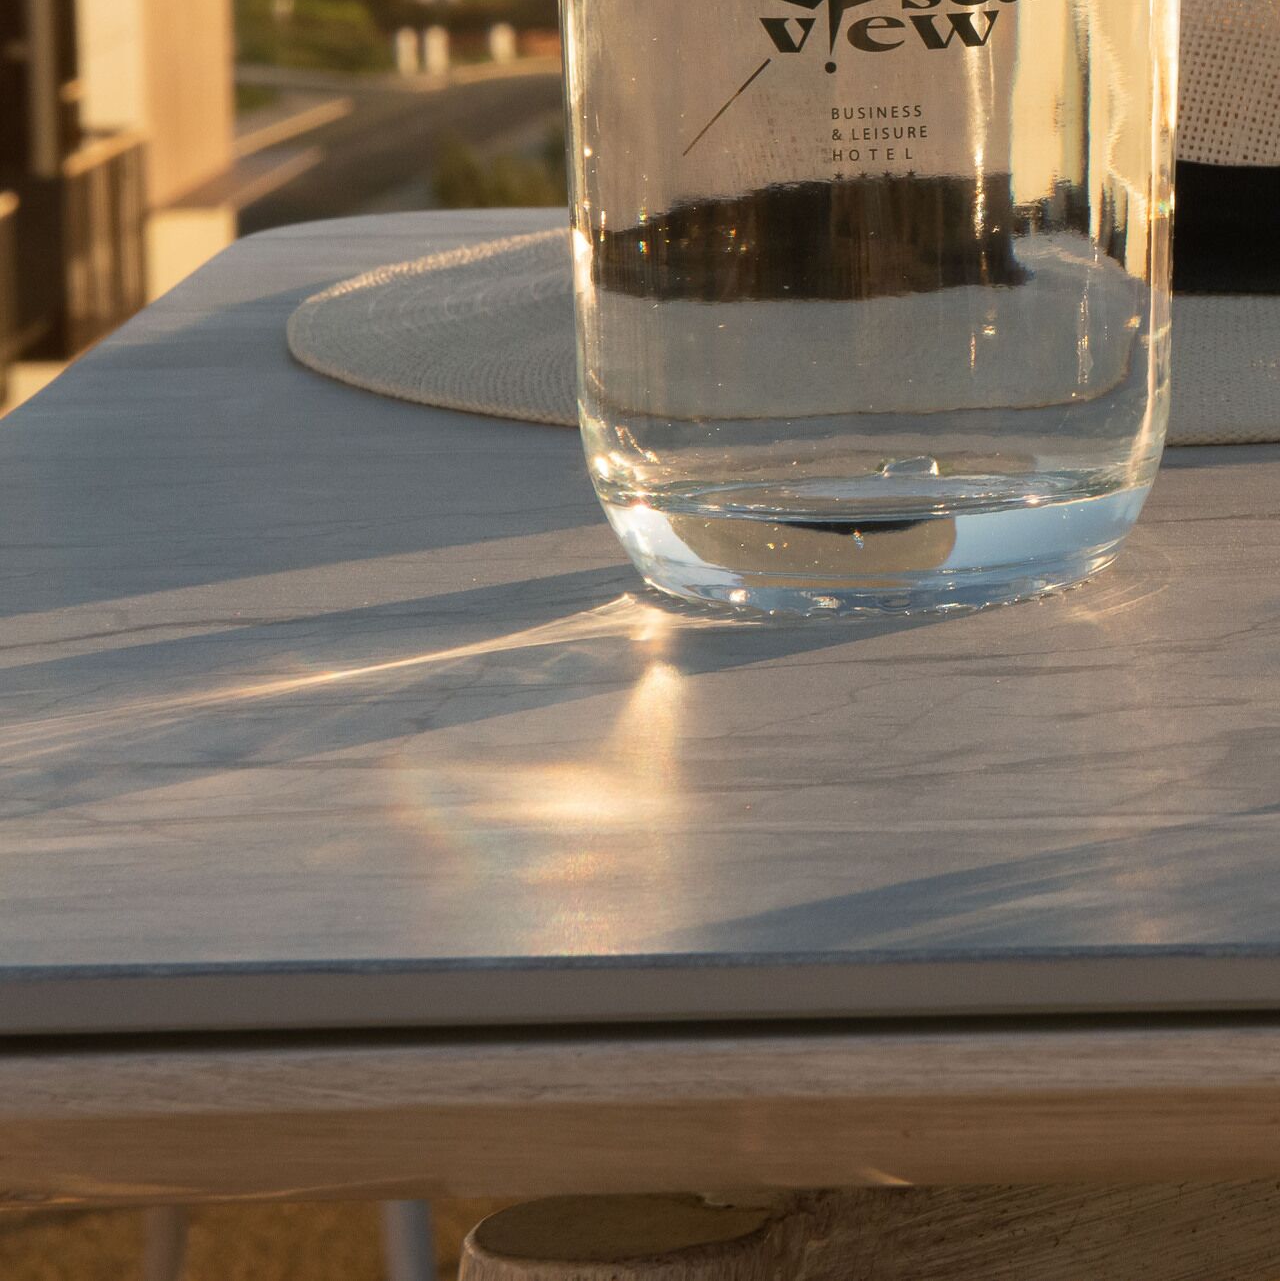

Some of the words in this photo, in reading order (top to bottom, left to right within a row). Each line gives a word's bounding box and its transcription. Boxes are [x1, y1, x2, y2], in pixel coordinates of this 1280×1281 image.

[759, 9, 999, 57] view
[831, 105, 922, 120] BUSINESS
[831, 128, 842, 141] &
[851, 125, 928, 141] LEISURE
[832, 147, 913, 161] HOTEL
